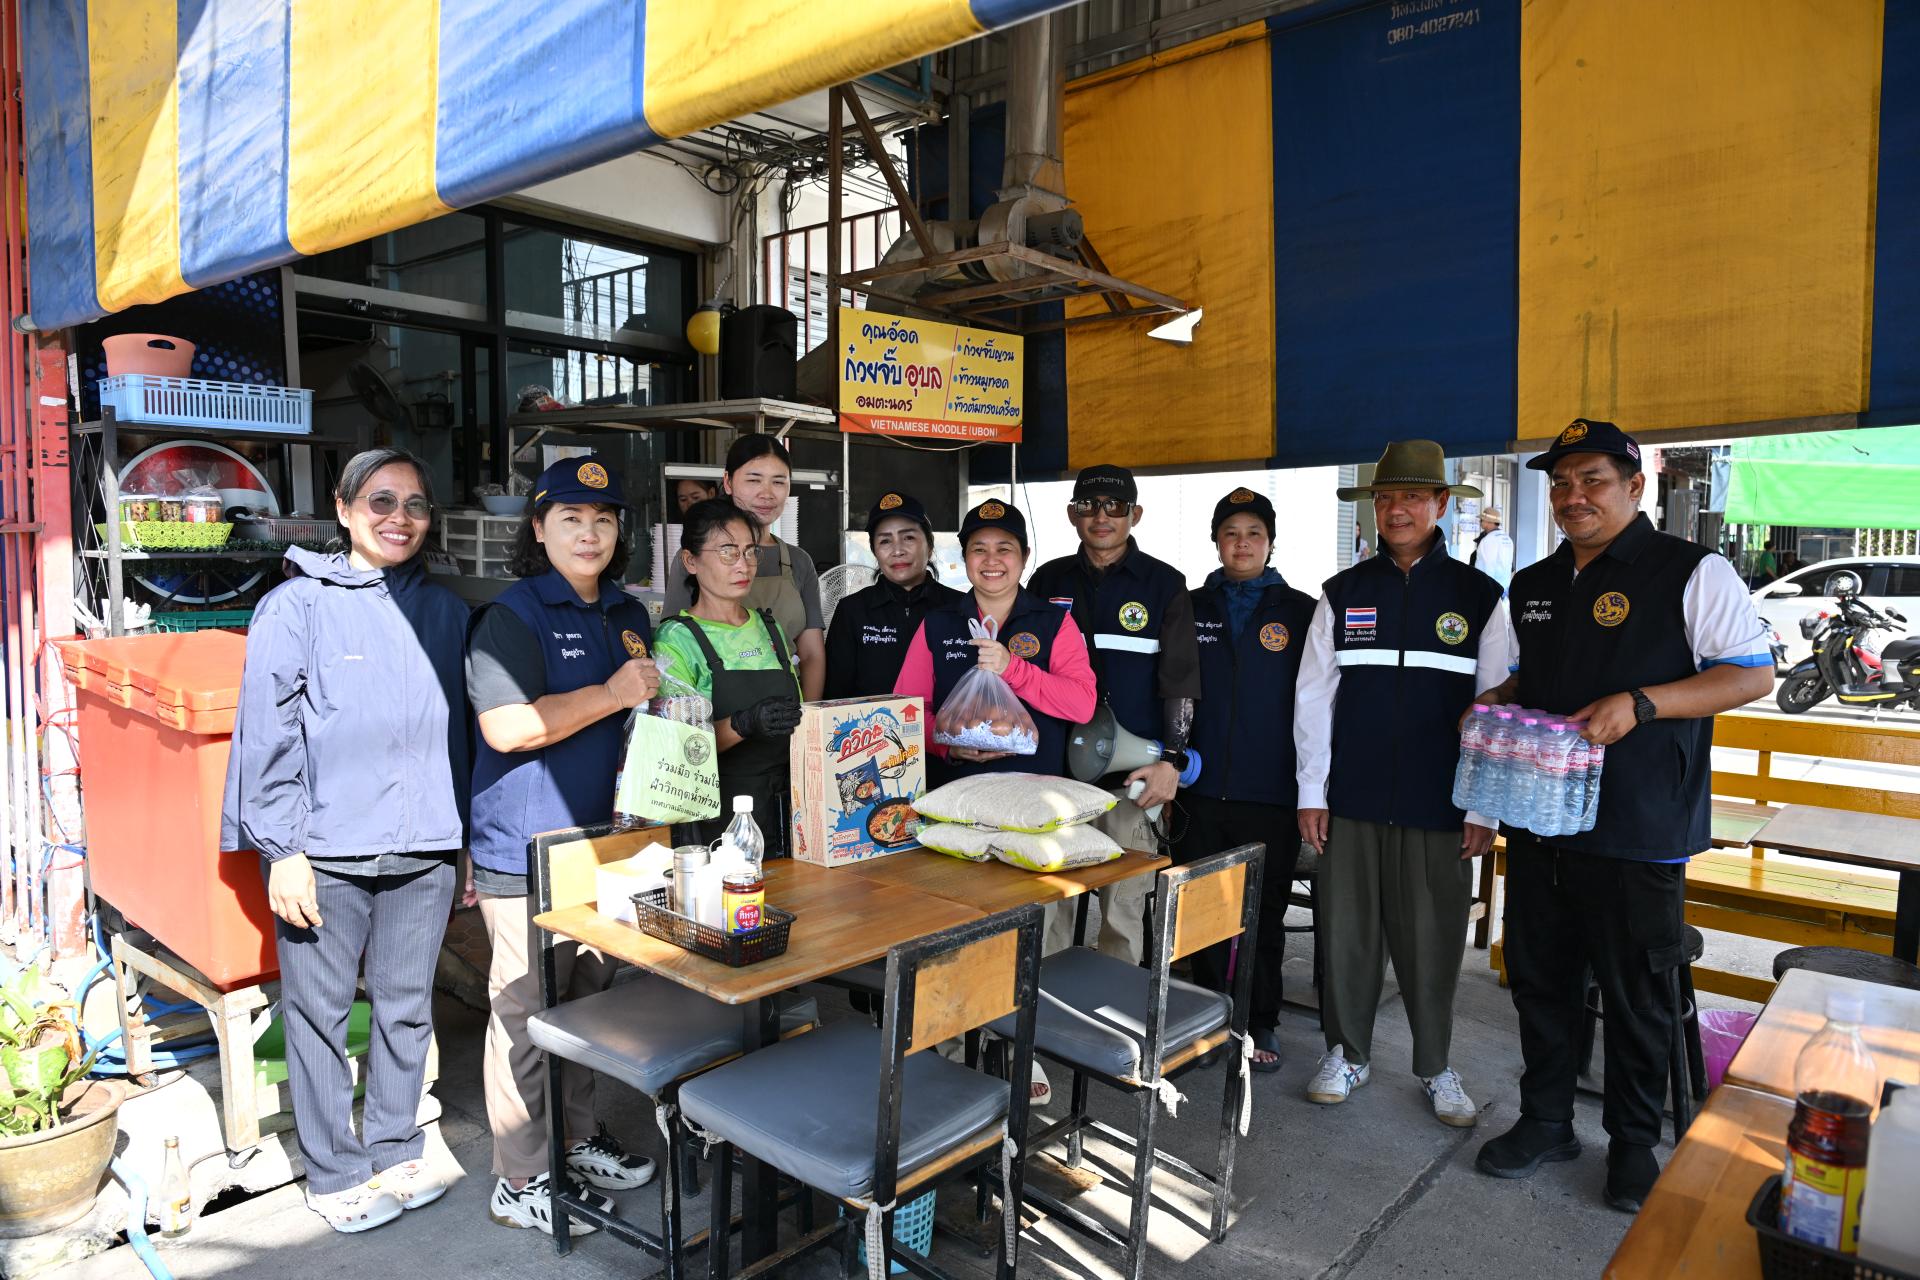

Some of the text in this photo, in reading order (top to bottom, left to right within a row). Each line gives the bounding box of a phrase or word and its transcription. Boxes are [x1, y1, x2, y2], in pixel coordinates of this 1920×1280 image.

[862, 319, 919, 344] คุณอ๊อด
[845, 344, 943, 397] ก๋วยจั๊บ อุบล
[958, 367, 1009, 392] ข้าวหมูทอด
[855, 395, 913, 412] อมตะนคร
[954, 396, 1020, 417] ข้าวต้มทรงเครื่อง
[870, 419, 998, 437] VIETNAMESE NOODLE (UBON)
[657, 758, 720, 789] ร่วมมือ ร่วมใจ
